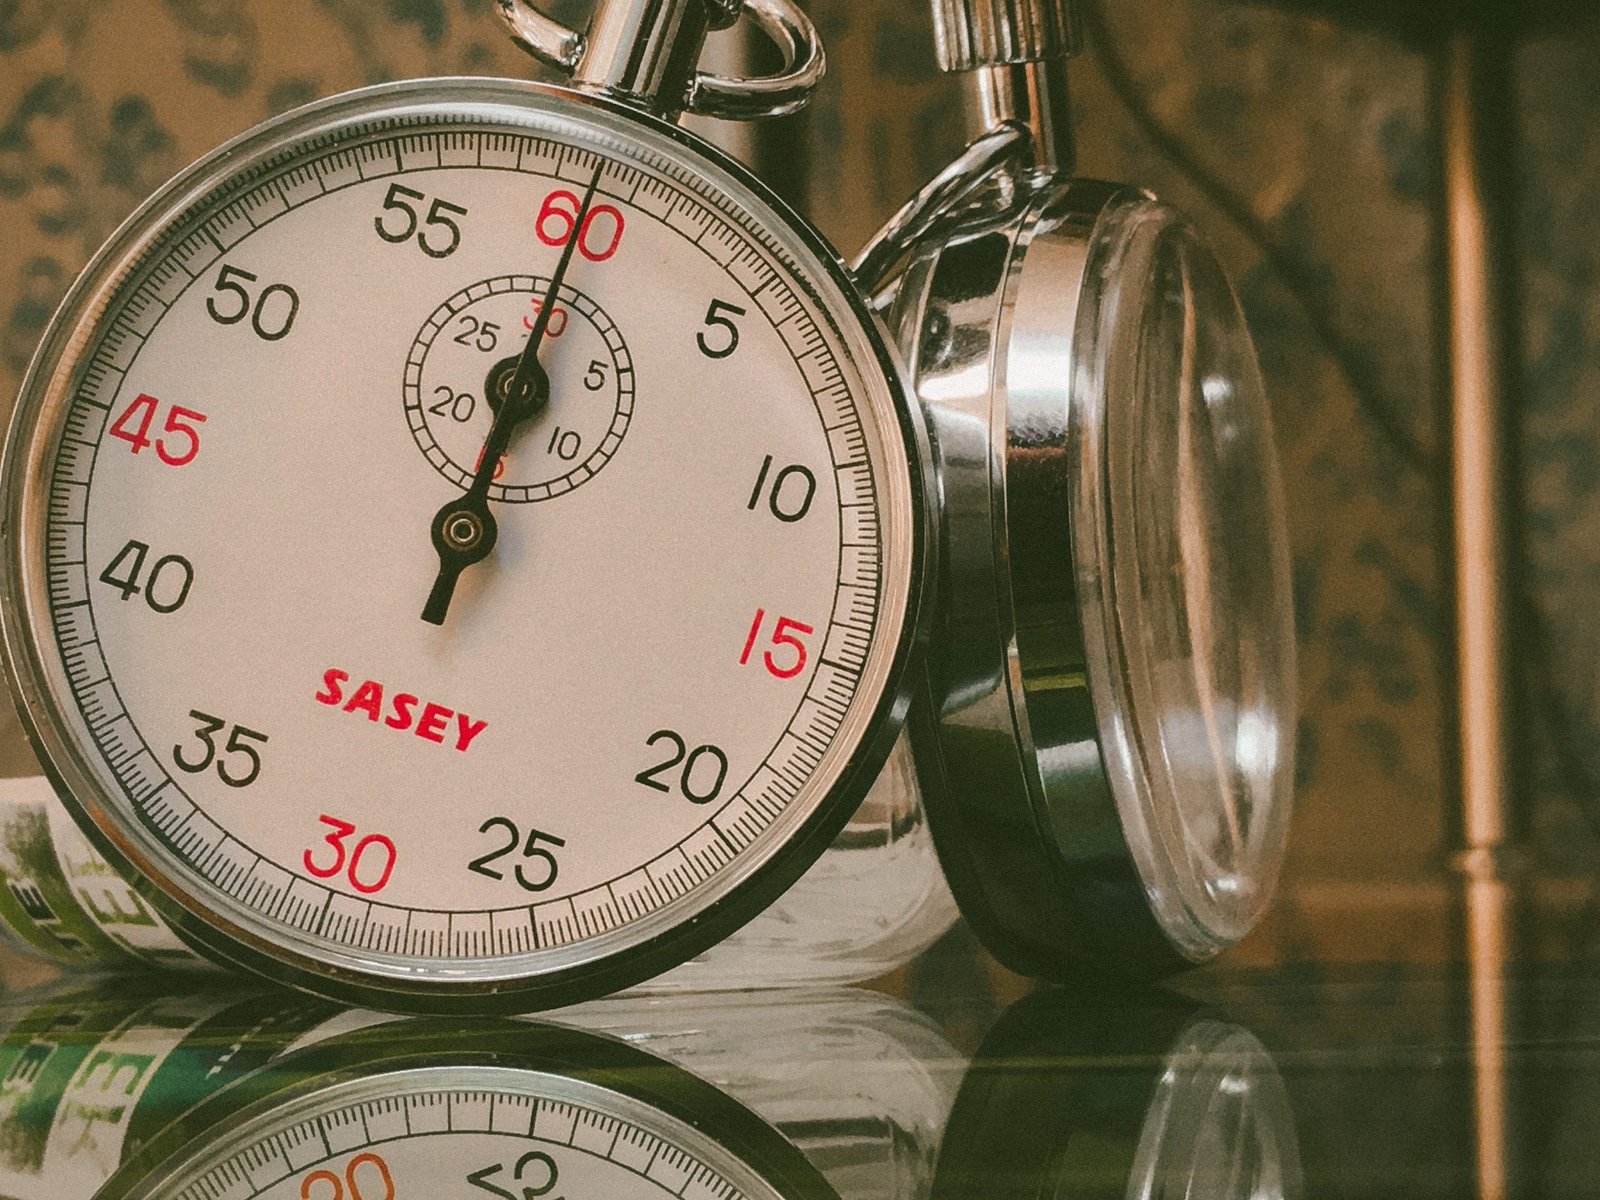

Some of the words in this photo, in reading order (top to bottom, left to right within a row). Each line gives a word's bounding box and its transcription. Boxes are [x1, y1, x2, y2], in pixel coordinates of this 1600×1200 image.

[374, 183, 468, 259] 55
[535, 190, 625, 262] 60
[206, 264, 300, 341] 50
[454, 315, 501, 353] 25
[523, 297, 568, 338] 30
[696, 298, 747, 360] 5
[428, 385, 476, 423] 20
[583, 359, 609, 391] 5
[109, 393, 207, 467] 45
[547, 426, 582, 461] 10
[747, 455, 816, 523] 10
[99, 540, 194, 613] 40
[740, 608, 813, 679] 15
[316, 668, 488, 752] SASEY
[173, 709, 269, 788] 35
[635, 730, 729, 804] 20
[303, 814, 396, 894] 30
[468, 816, 566, 892] 25
